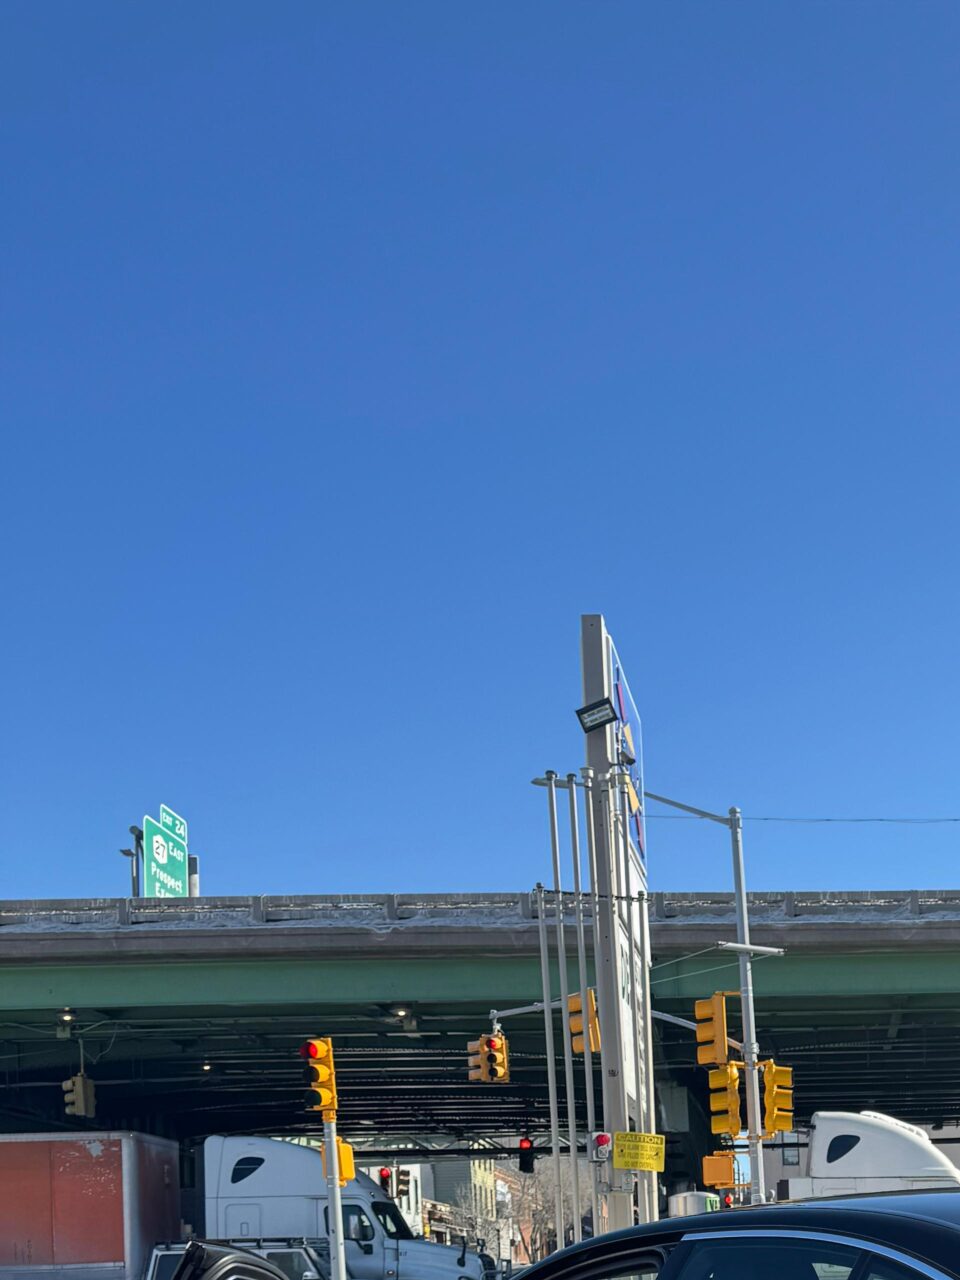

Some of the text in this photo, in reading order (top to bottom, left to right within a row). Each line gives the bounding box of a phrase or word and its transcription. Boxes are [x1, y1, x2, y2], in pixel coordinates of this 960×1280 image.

[175, 820, 185, 837] 24
[155, 840, 184, 863] 27 EAST
[151, 861, 183, 894] Prospect
[618, 1134, 661, 1144] CAUTION
